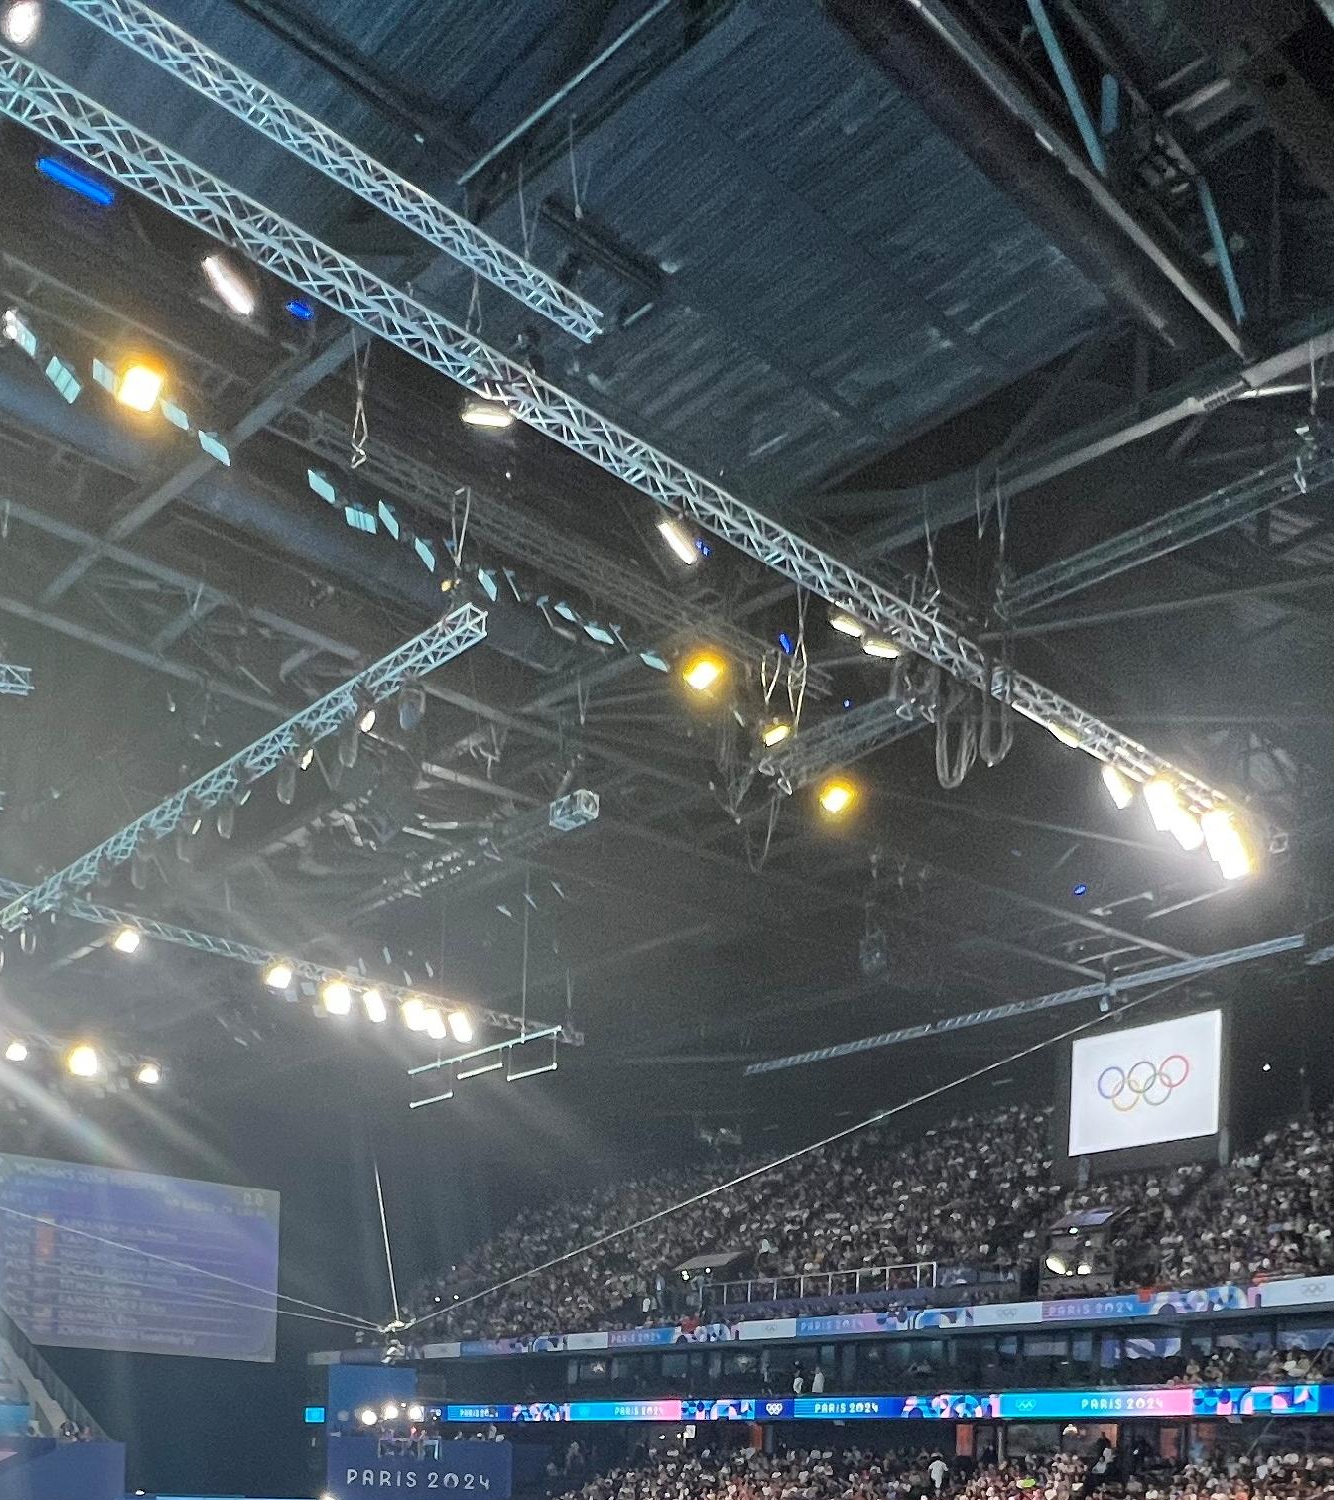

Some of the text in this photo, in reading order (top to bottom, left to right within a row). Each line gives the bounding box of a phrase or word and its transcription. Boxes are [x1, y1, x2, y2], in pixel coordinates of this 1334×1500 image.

[814, 1402, 878, 1413] PARIS 2024
[1081, 1397, 1164, 1409] PARIS 2024
[346, 1468, 490, 1490] PARIS 2024
